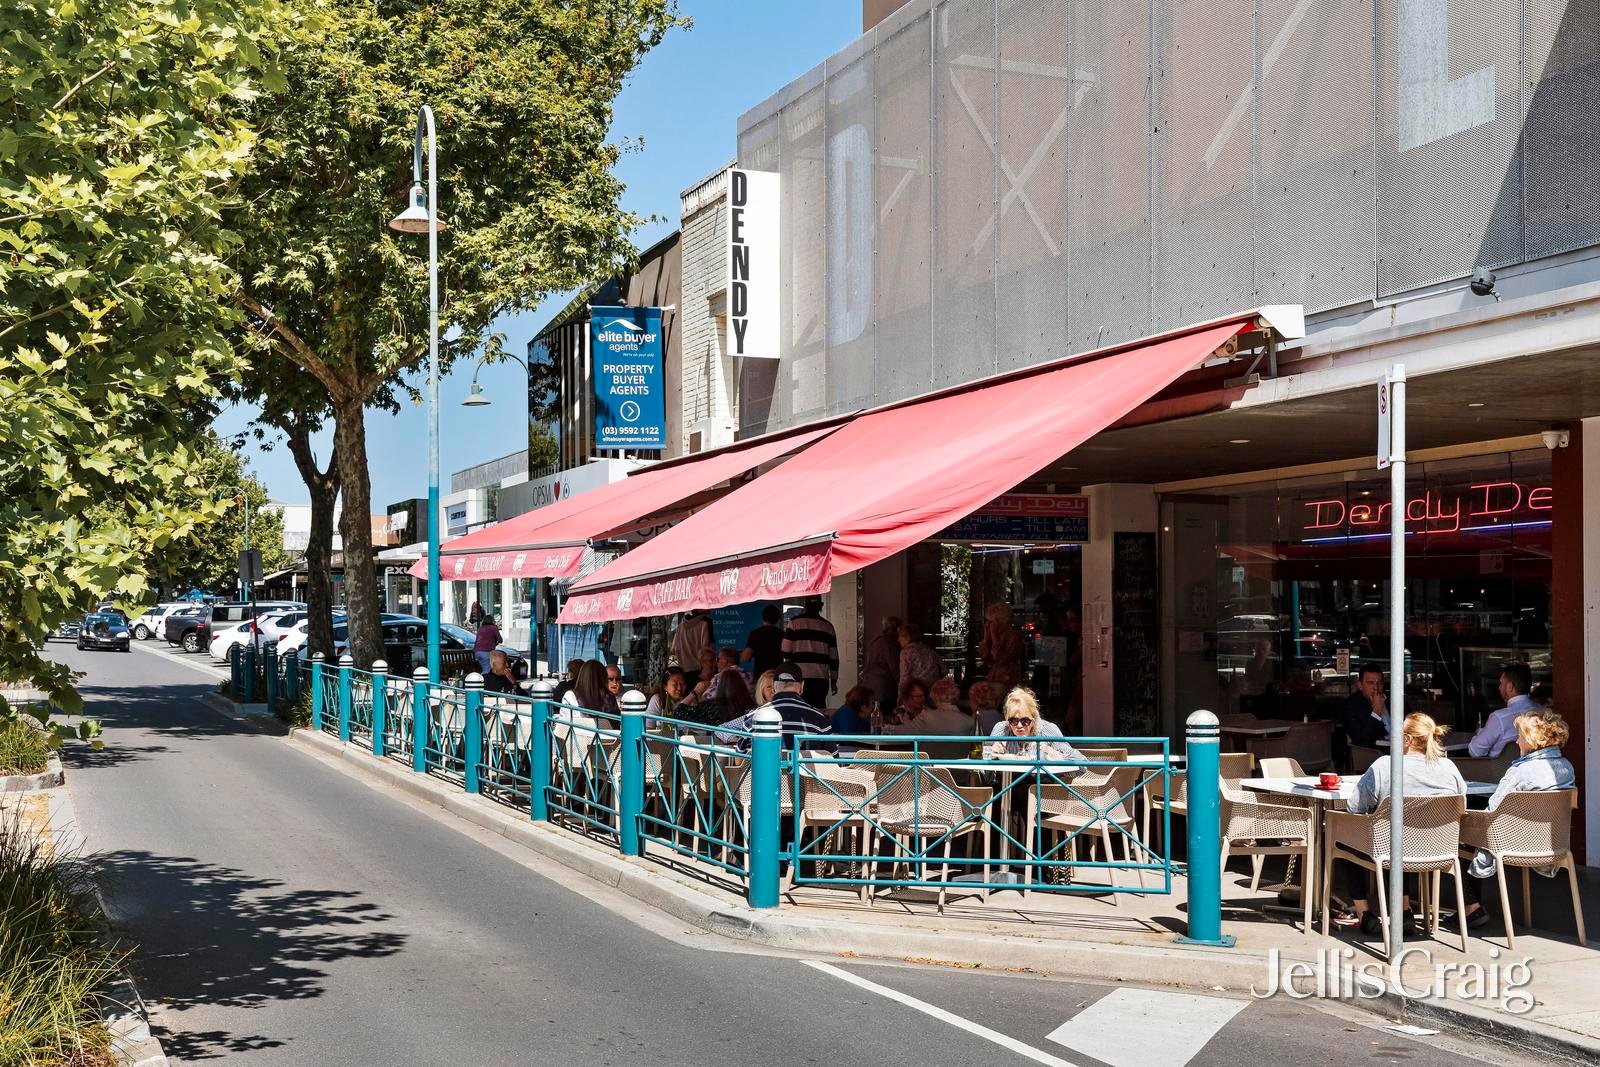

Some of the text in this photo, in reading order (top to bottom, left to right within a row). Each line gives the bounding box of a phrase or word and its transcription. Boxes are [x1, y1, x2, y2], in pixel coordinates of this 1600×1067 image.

[731, 171, 750, 354] DENDY
[598, 330, 657, 345] elite buyer
[608, 342, 639, 352] agents
[603, 364, 655, 374] PROPERTY
[612, 375, 646, 385] BUYER
[609, 385, 650, 395] AGENTS
[602, 426, 660, 436] (03) 9592 1122
[532, 483, 551, 507] OPSM
[1026, 497, 1086, 512] Deli
[760, 559, 810, 588] Dendy Deli
[674, 576, 693, 601] BAR
